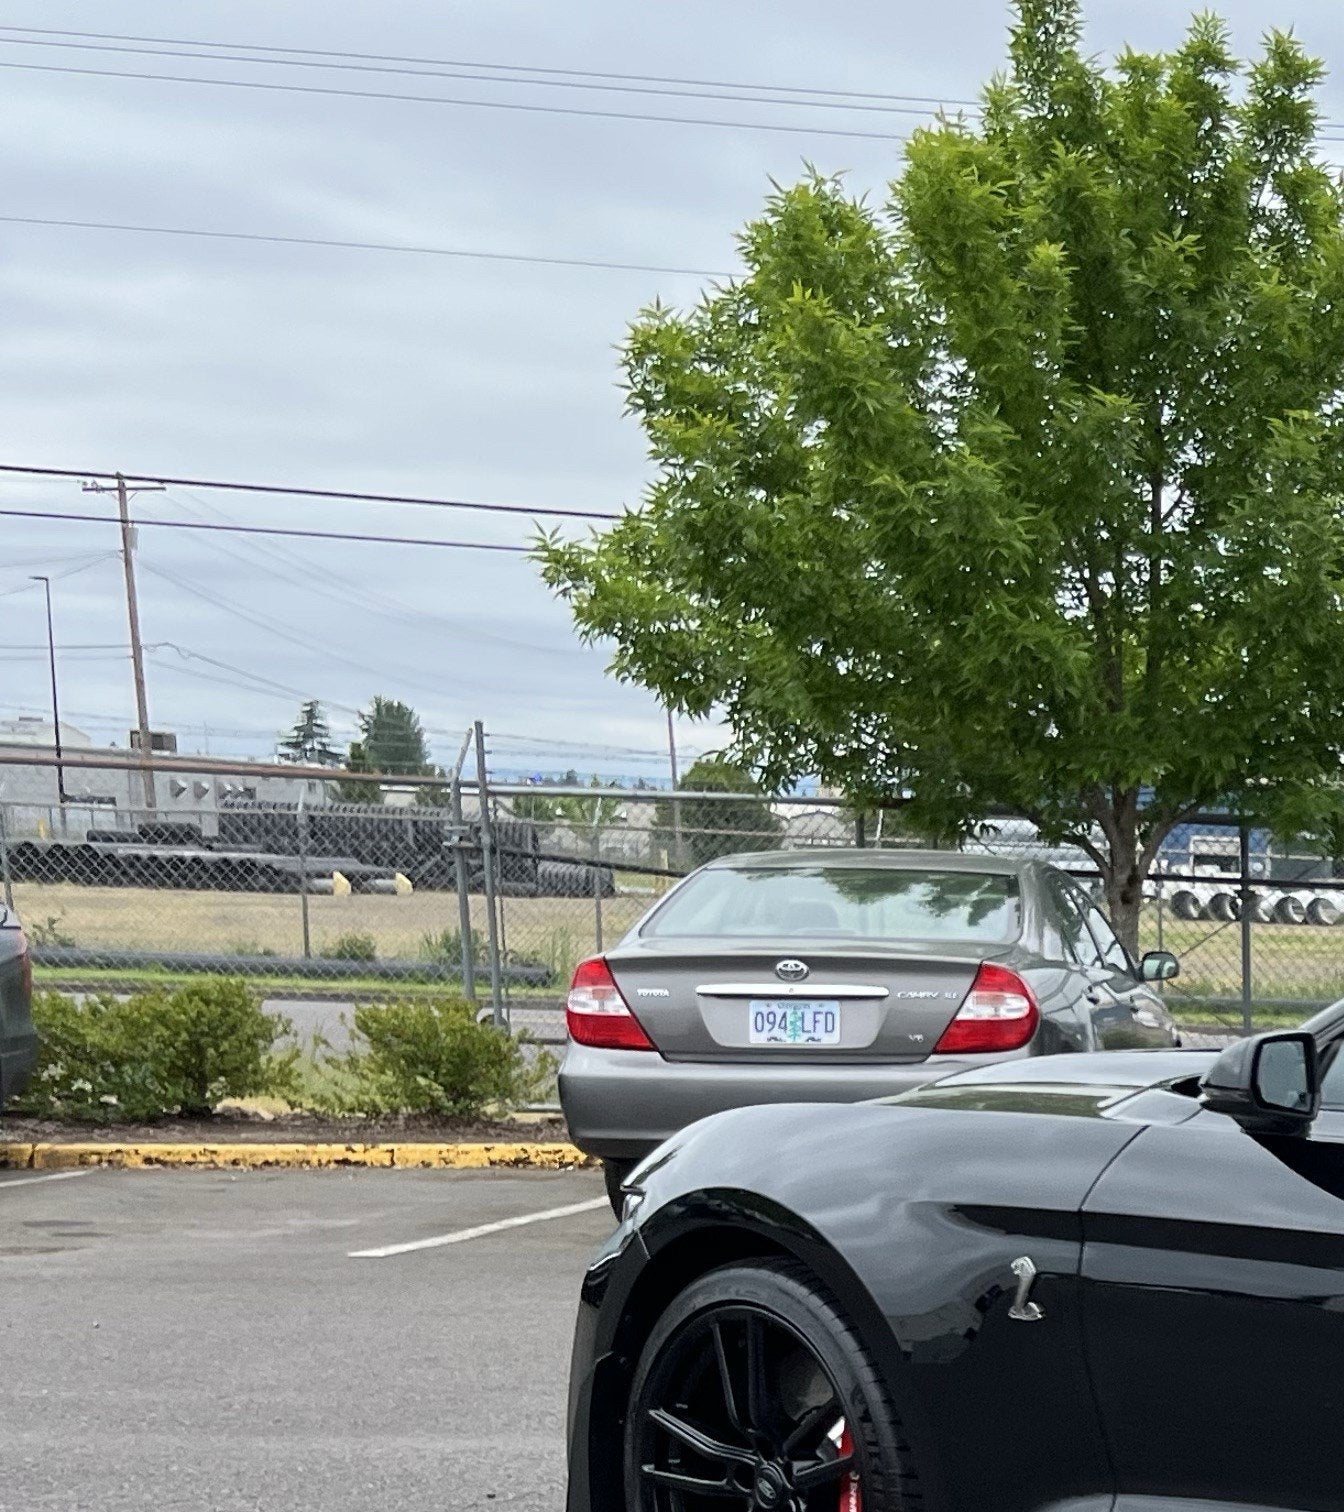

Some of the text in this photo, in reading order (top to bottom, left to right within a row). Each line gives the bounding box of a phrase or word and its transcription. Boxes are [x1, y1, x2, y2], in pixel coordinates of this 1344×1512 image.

[636, 988, 670, 997] TOYOTA
[897, 991, 940, 999] CAMRY
[754, 1011, 835, 1034] 094 LFD
[908, 1033, 924, 1043] V6
